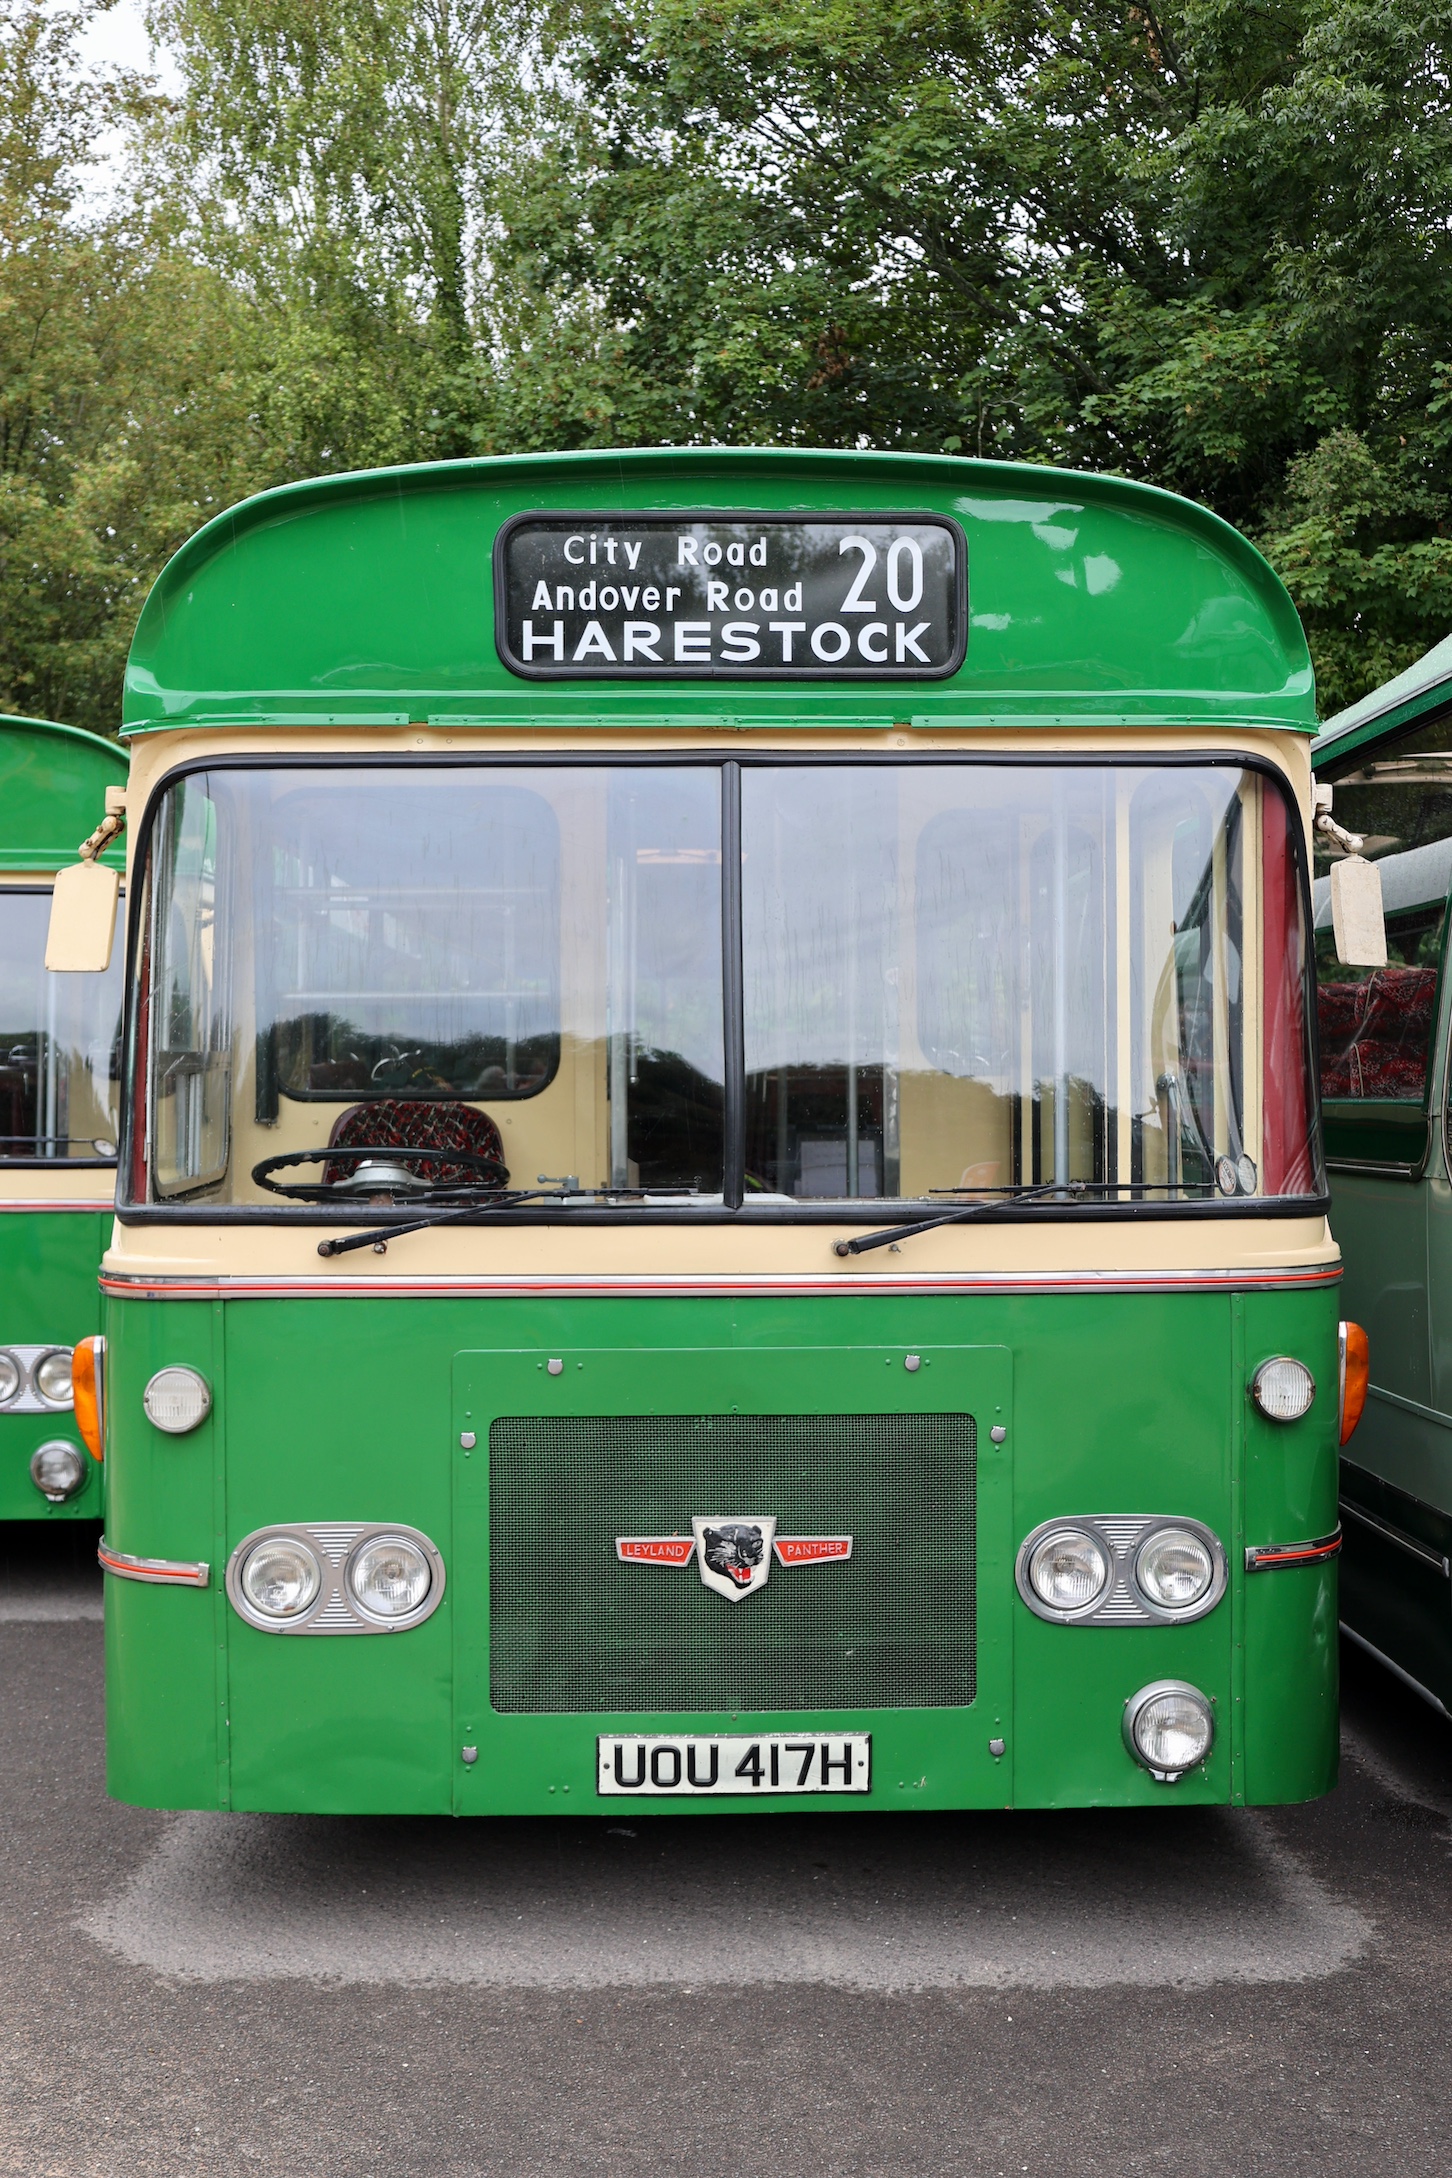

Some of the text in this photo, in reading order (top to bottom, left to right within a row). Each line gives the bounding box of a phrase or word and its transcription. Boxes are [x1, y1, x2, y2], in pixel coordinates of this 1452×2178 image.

[563, 533, 767, 571] City Road
[838, 535, 924, 614] 20
[531, 580, 803, 612] Andover Road
[522, 620, 932, 664] HARESTOCK
[626, 1543, 685, 1558] LEYLAND
[787, 1542, 843, 1556] PANTHER
[614, 1742, 852, 1788] UOU 417H
